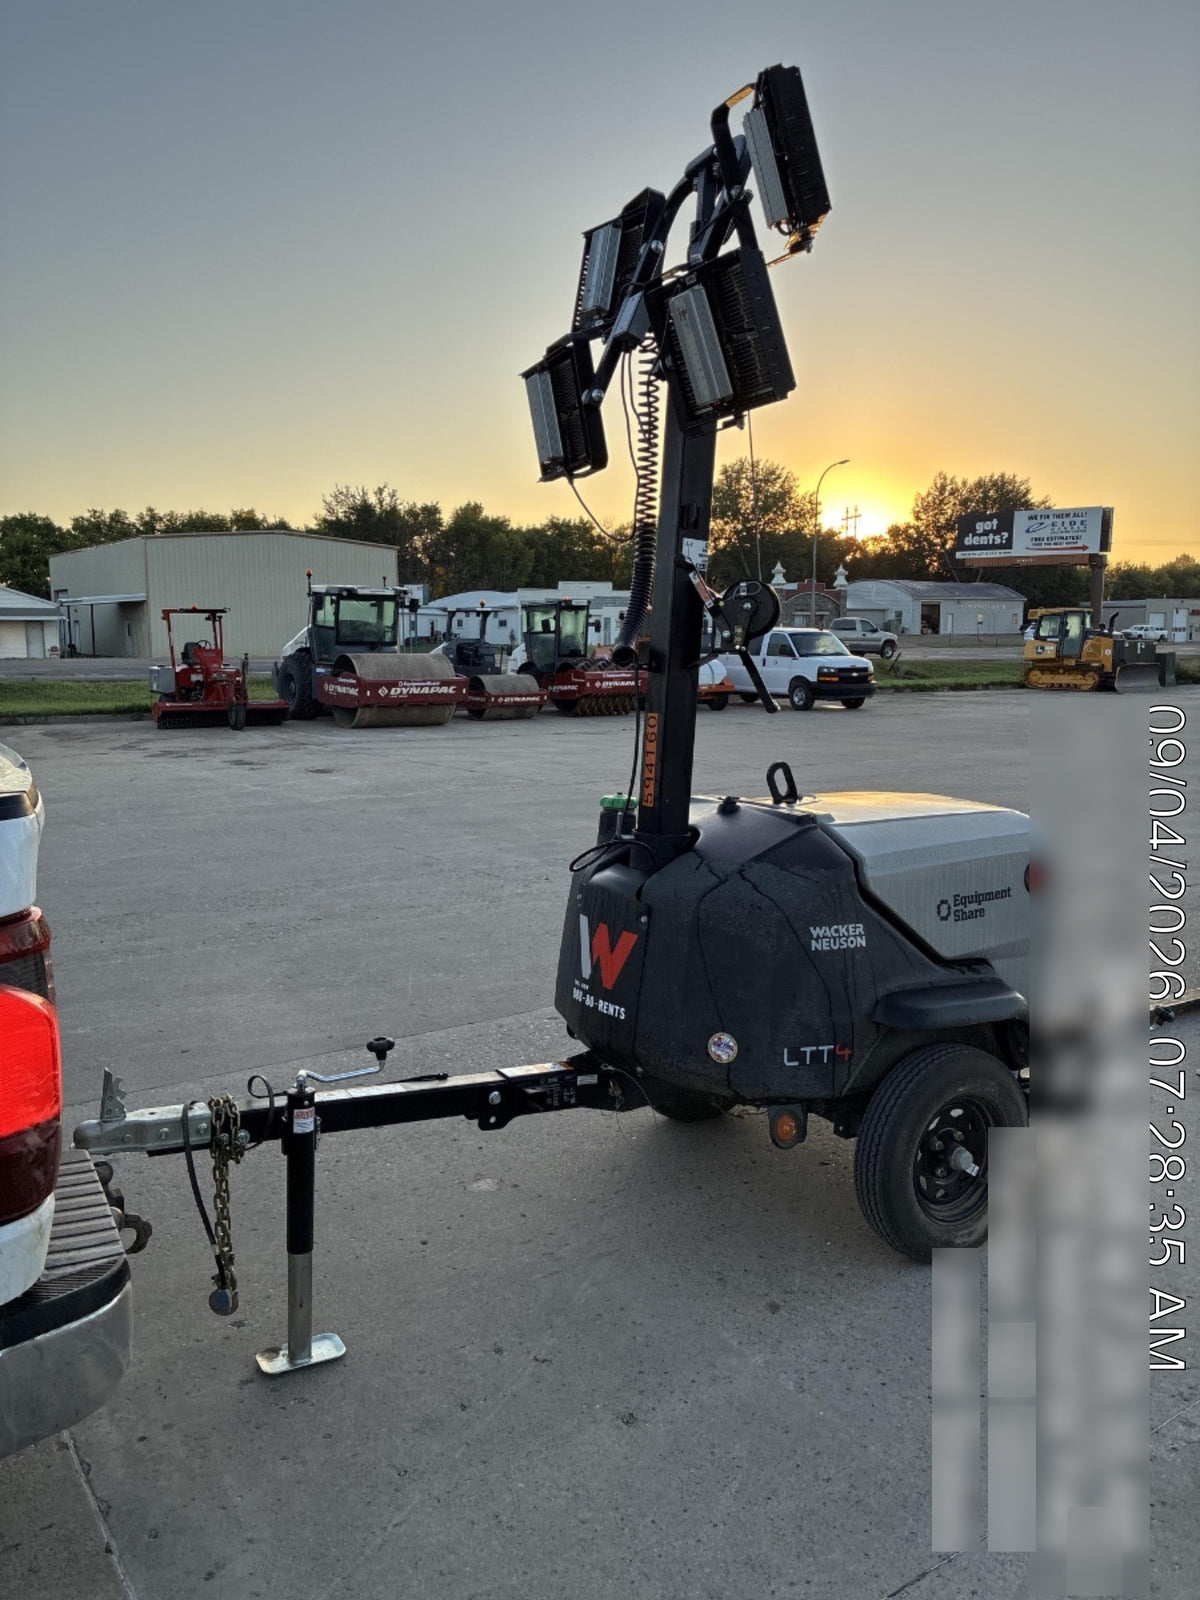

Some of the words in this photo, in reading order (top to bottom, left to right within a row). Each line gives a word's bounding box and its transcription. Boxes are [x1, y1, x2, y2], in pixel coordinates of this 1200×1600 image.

[975, 518, 998, 534] got
[964, 532, 1009, 546] dents?
[389, 685, 456, 696] DYNAPAC
[643, 716, 657, 804] 594160
[953, 887, 1012, 909] Equipment
[953, 907, 985, 922] Share
[809, 923, 865, 938] WACKER
[811, 936, 867, 951] NEUSON
[783, 1045, 852, 1066] LTT4
